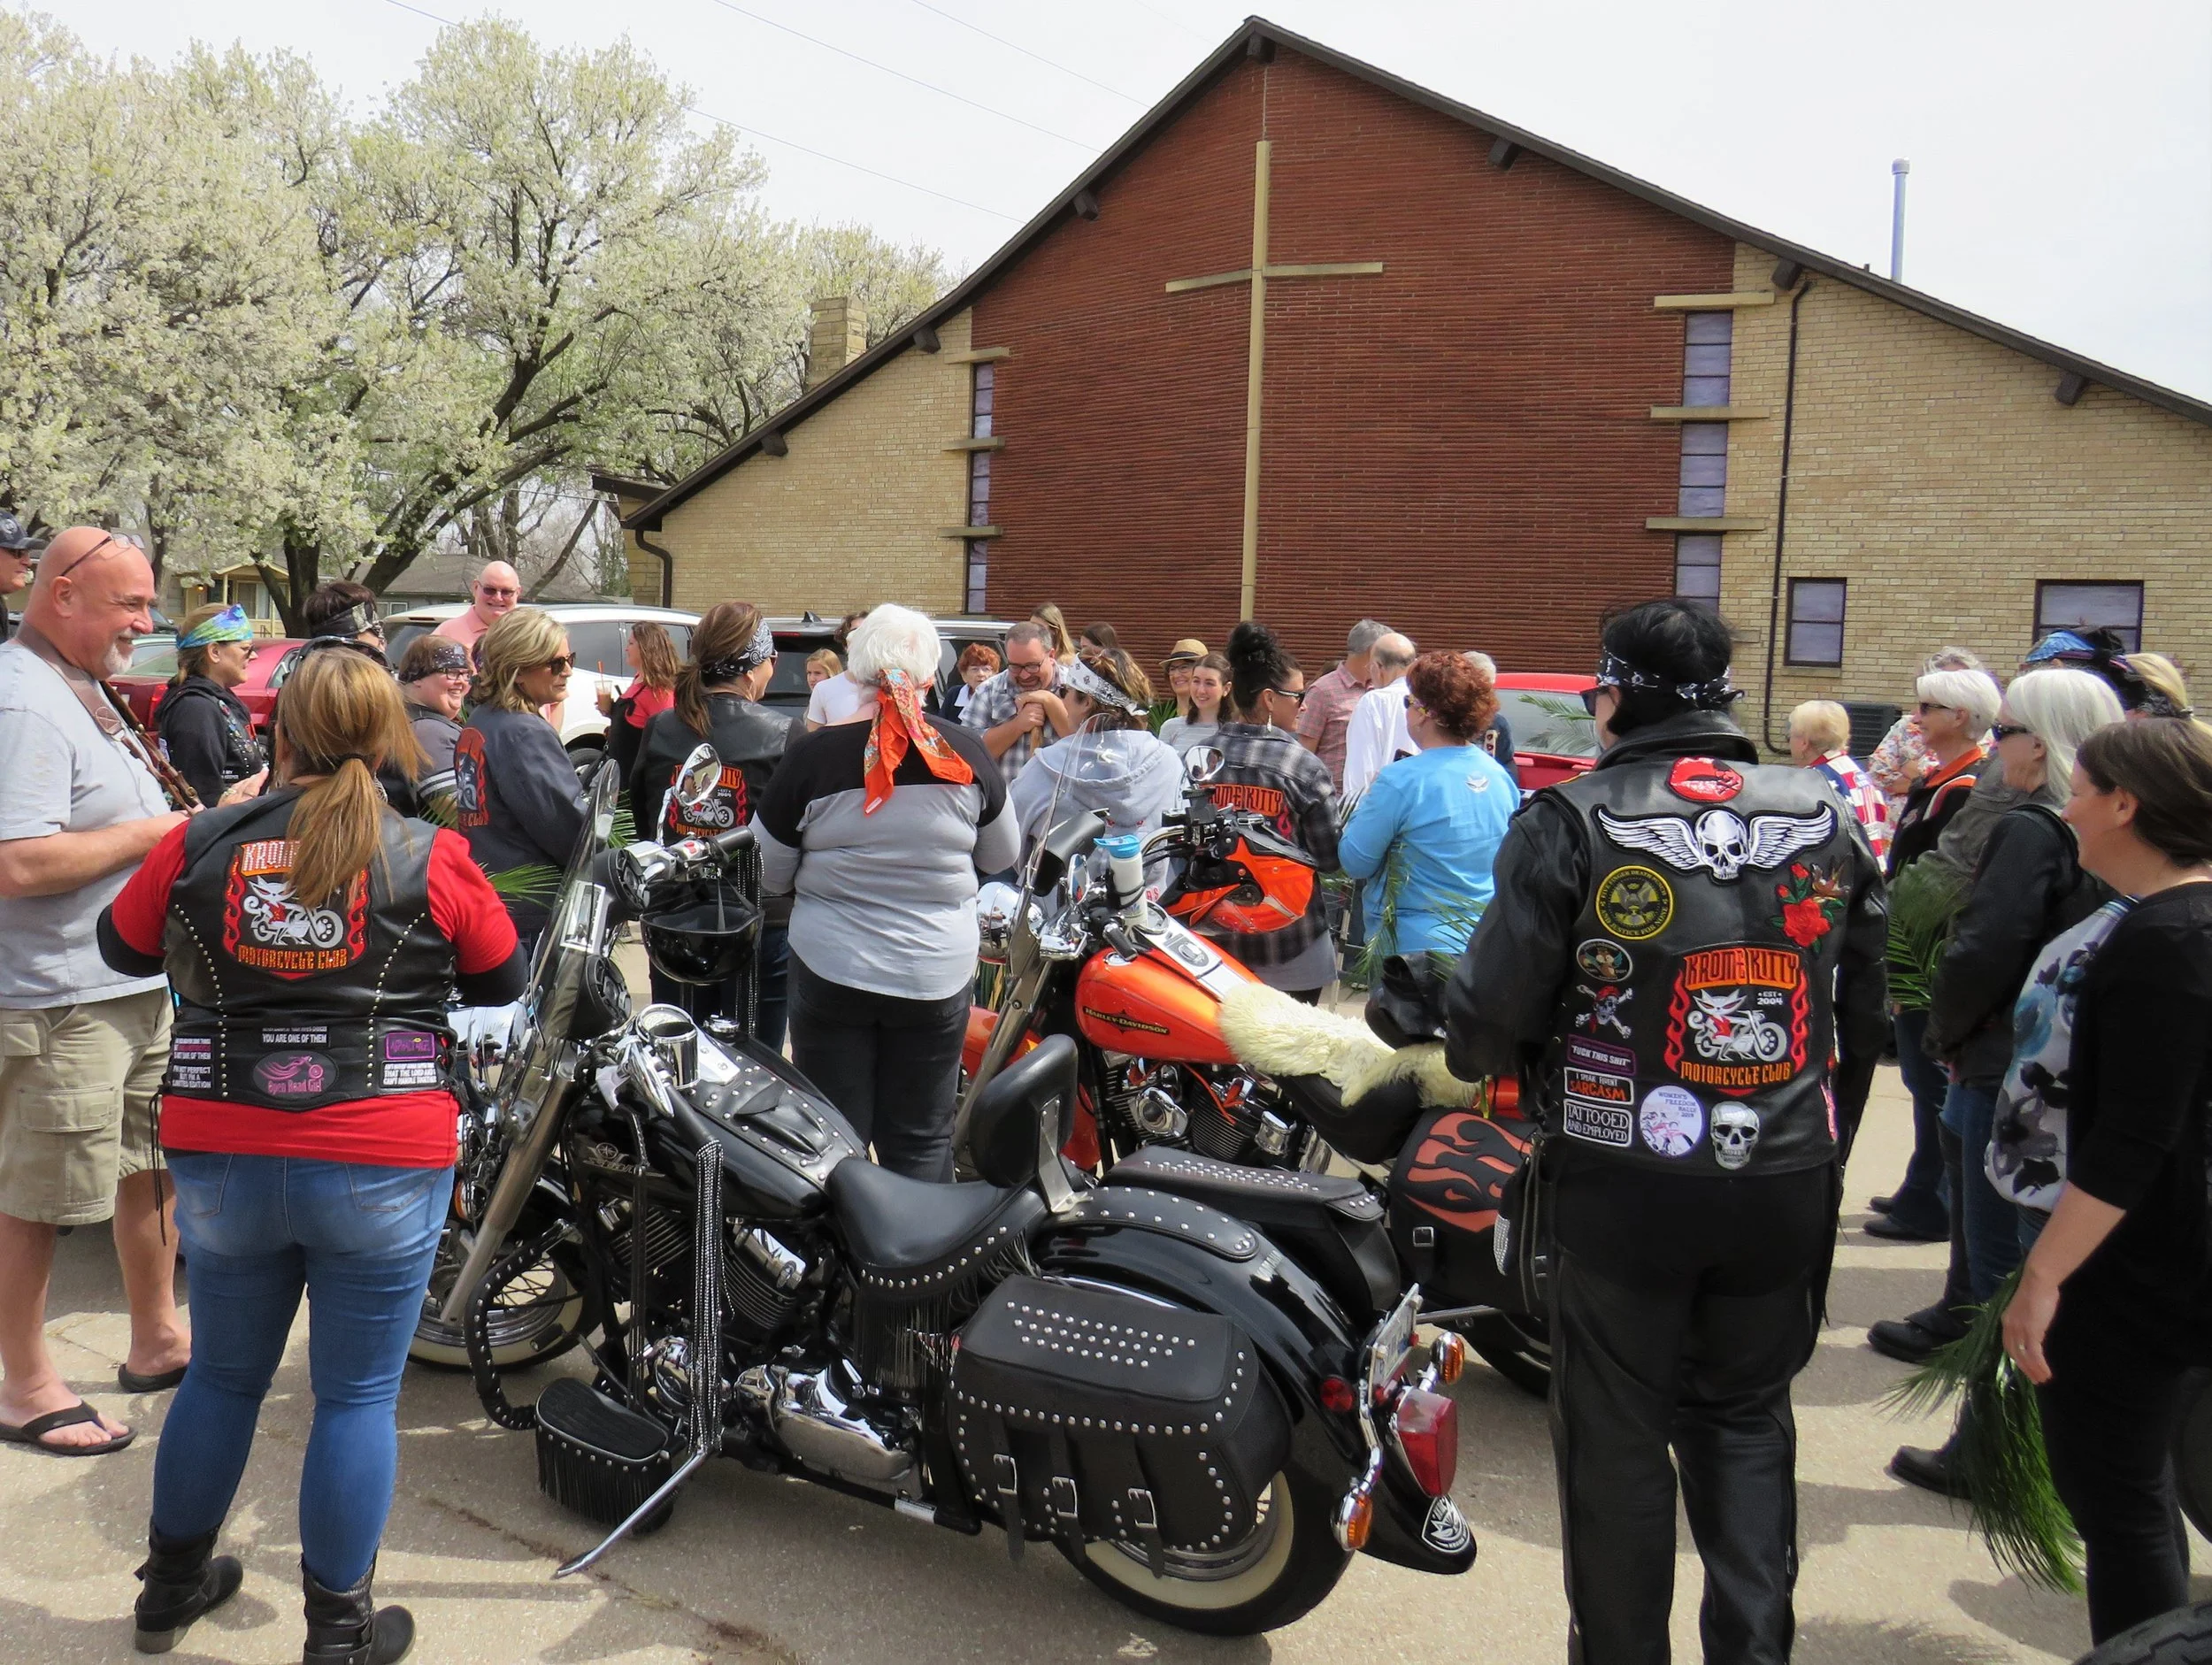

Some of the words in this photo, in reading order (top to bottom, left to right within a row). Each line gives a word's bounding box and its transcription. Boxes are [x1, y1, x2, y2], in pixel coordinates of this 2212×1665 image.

[1244, 786, 1282, 814] KITTY
[1631, 870, 1653, 879] DEATH
[1610, 924, 1640, 936] JUSTICE
[1640, 924, 1656, 935] FOR
[1654, 908, 1668, 925] NONE
[238, 944, 315, 969] MOTORCYCLE
[318, 948, 348, 970] CLUB
[1685, 948, 1747, 988] KROME
[1747, 948, 1799, 988] KITTY
[1085, 1008, 1168, 1033] HARLEY-DAVIDSON
[262, 1033, 275, 1043] YOU
[275, 1033, 288, 1043] ARE
[288, 1033, 301, 1043] ONE
[301, 1033, 310, 1043] OF
[310, 1033, 327, 1043] THEM
[1592, 1051, 1609, 1063] THIS
[1580, 1073, 1596, 1083] SPEAK
[1599, 1076, 1618, 1086] FLUENT
[1681, 1061, 1760, 1086] MOTORCYCLE
[1762, 1062, 1791, 1082] CLUB
[1570, 1080, 1627, 1101] SARCASM
[1567, 1102, 1628, 1129] TATTOOED
[1567, 1119, 1582, 1132] AND
[1582, 1123, 1627, 1141] EMPLOYED
